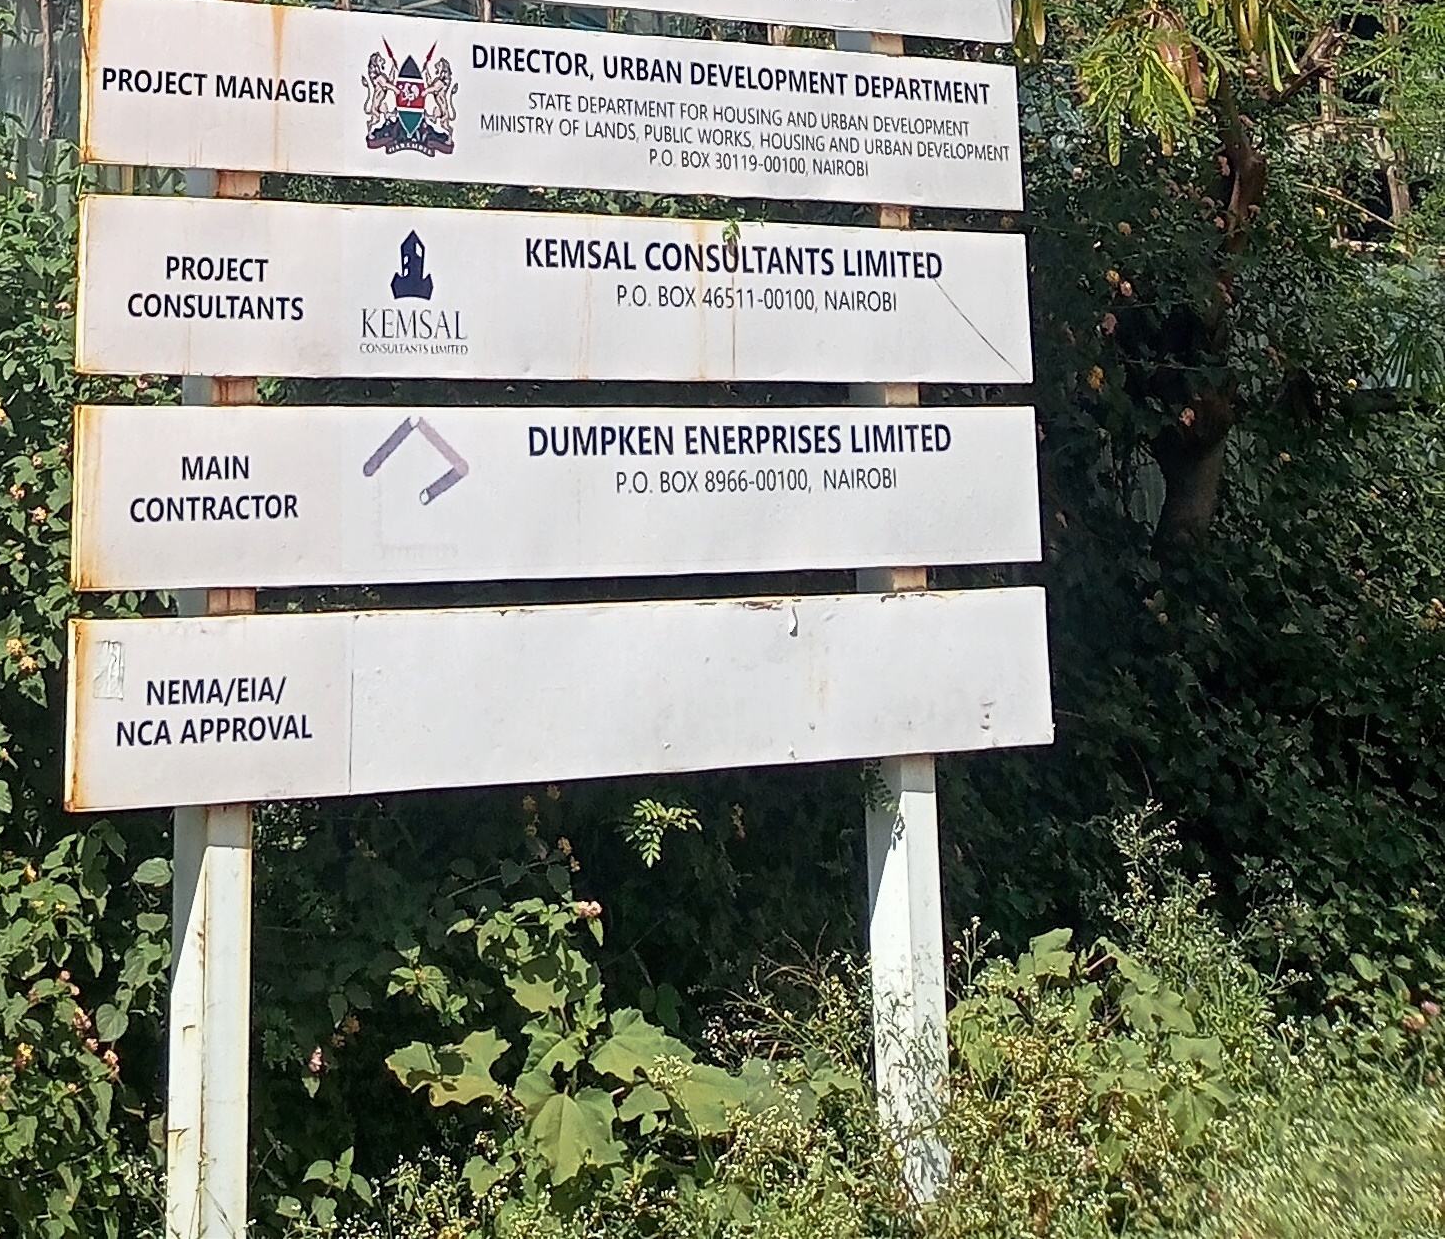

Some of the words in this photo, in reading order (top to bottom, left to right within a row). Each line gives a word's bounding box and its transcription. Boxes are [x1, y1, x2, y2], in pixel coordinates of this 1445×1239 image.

[102, 67, 208, 97] PROJECT
[215, 74, 335, 106] MANAGER
[472, 44, 594, 81] DIRECTOR,
[603, 55, 683, 84] URBAN
[690, 62, 849, 96] DEVELOPMENT
[854, 74, 991, 105] DEPARTMENT
[528, 92, 572, 112] STATE
[578, 95, 677, 120] DEPARTMENT
[680, 102, 709, 121] FOR
[713, 105, 782, 127] HOUSING
[786, 110, 818, 129] AND
[821, 113, 869, 133] URBAN
[873, 115, 970, 137] DEVELOPMENT
[480, 114, 554, 137] MINISTRY
[559, 118, 580, 137] OF
[585, 119, 640, 143] LANDS,
[644, 124, 693, 145] PUBLIC
[697, 128, 755, 150] WORKS,
[759, 132, 825, 153] HOUSING
[828, 136, 860, 155] AND
[864, 138, 913, 157] URBAN
[917, 140, 1010, 162] DEVELOPMENT
[649, 148, 677, 168] P.O.
[681, 150, 710, 170] BOX
[715, 152, 809, 177] 30119-00100,
[812, 157, 868, 178] NAIROBI
[165, 255, 269, 283] PROJECT
[524, 237, 637, 271] KEMSAL
[645, 241, 835, 277] CONSULTANTS
[843, 249, 943, 280] LIMITED
[127, 293, 305, 321] CONSULTANTS
[616, 284, 651, 307] P.O.
[658, 286, 697, 308] BOX
[701, 287, 820, 314] 46511-00100,
[824, 290, 897, 312] NAIROBI
[361, 308, 468, 340] KEMSAL
[359, 342, 428, 355] CONSULTANTS
[430, 344, 469, 356] LIMITED
[528, 425, 675, 457] DUMPKEN
[685, 424, 842, 455] ENERPRISES
[850, 423, 952, 453] LIMITED
[181, 455, 250, 481] MAIN
[616, 471, 653, 494] P.O.
[660, 470, 700, 494] BOX
[704, 469, 812, 494] 8966-00100,
[823, 467, 897, 491] NAIROBI
[130, 494, 299, 523] CONTRACTOR
[146, 676, 288, 707] NEMA/EIA/
[116, 719, 172, 747] NCA
[179, 714, 313, 744] APPROVAL
